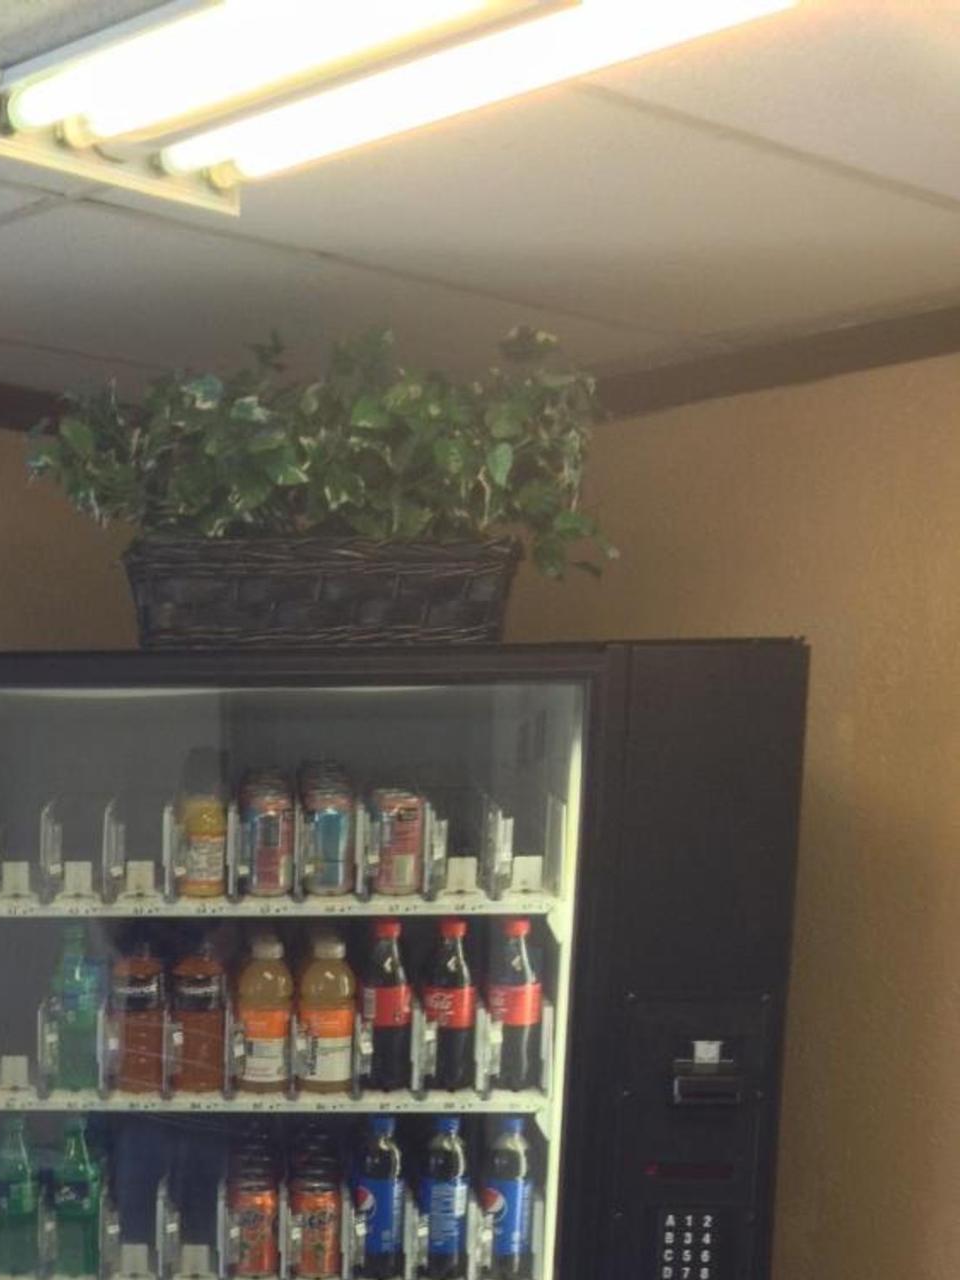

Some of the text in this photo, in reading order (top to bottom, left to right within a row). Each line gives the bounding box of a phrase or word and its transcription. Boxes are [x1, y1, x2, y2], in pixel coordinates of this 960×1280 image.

[665, 1214, 713, 1228] A 1 2
[664, 1231, 711, 1244] B 3 4
[663, 1249, 710, 1262] C 5 6
[662, 1266, 709, 1280] D 7 8
